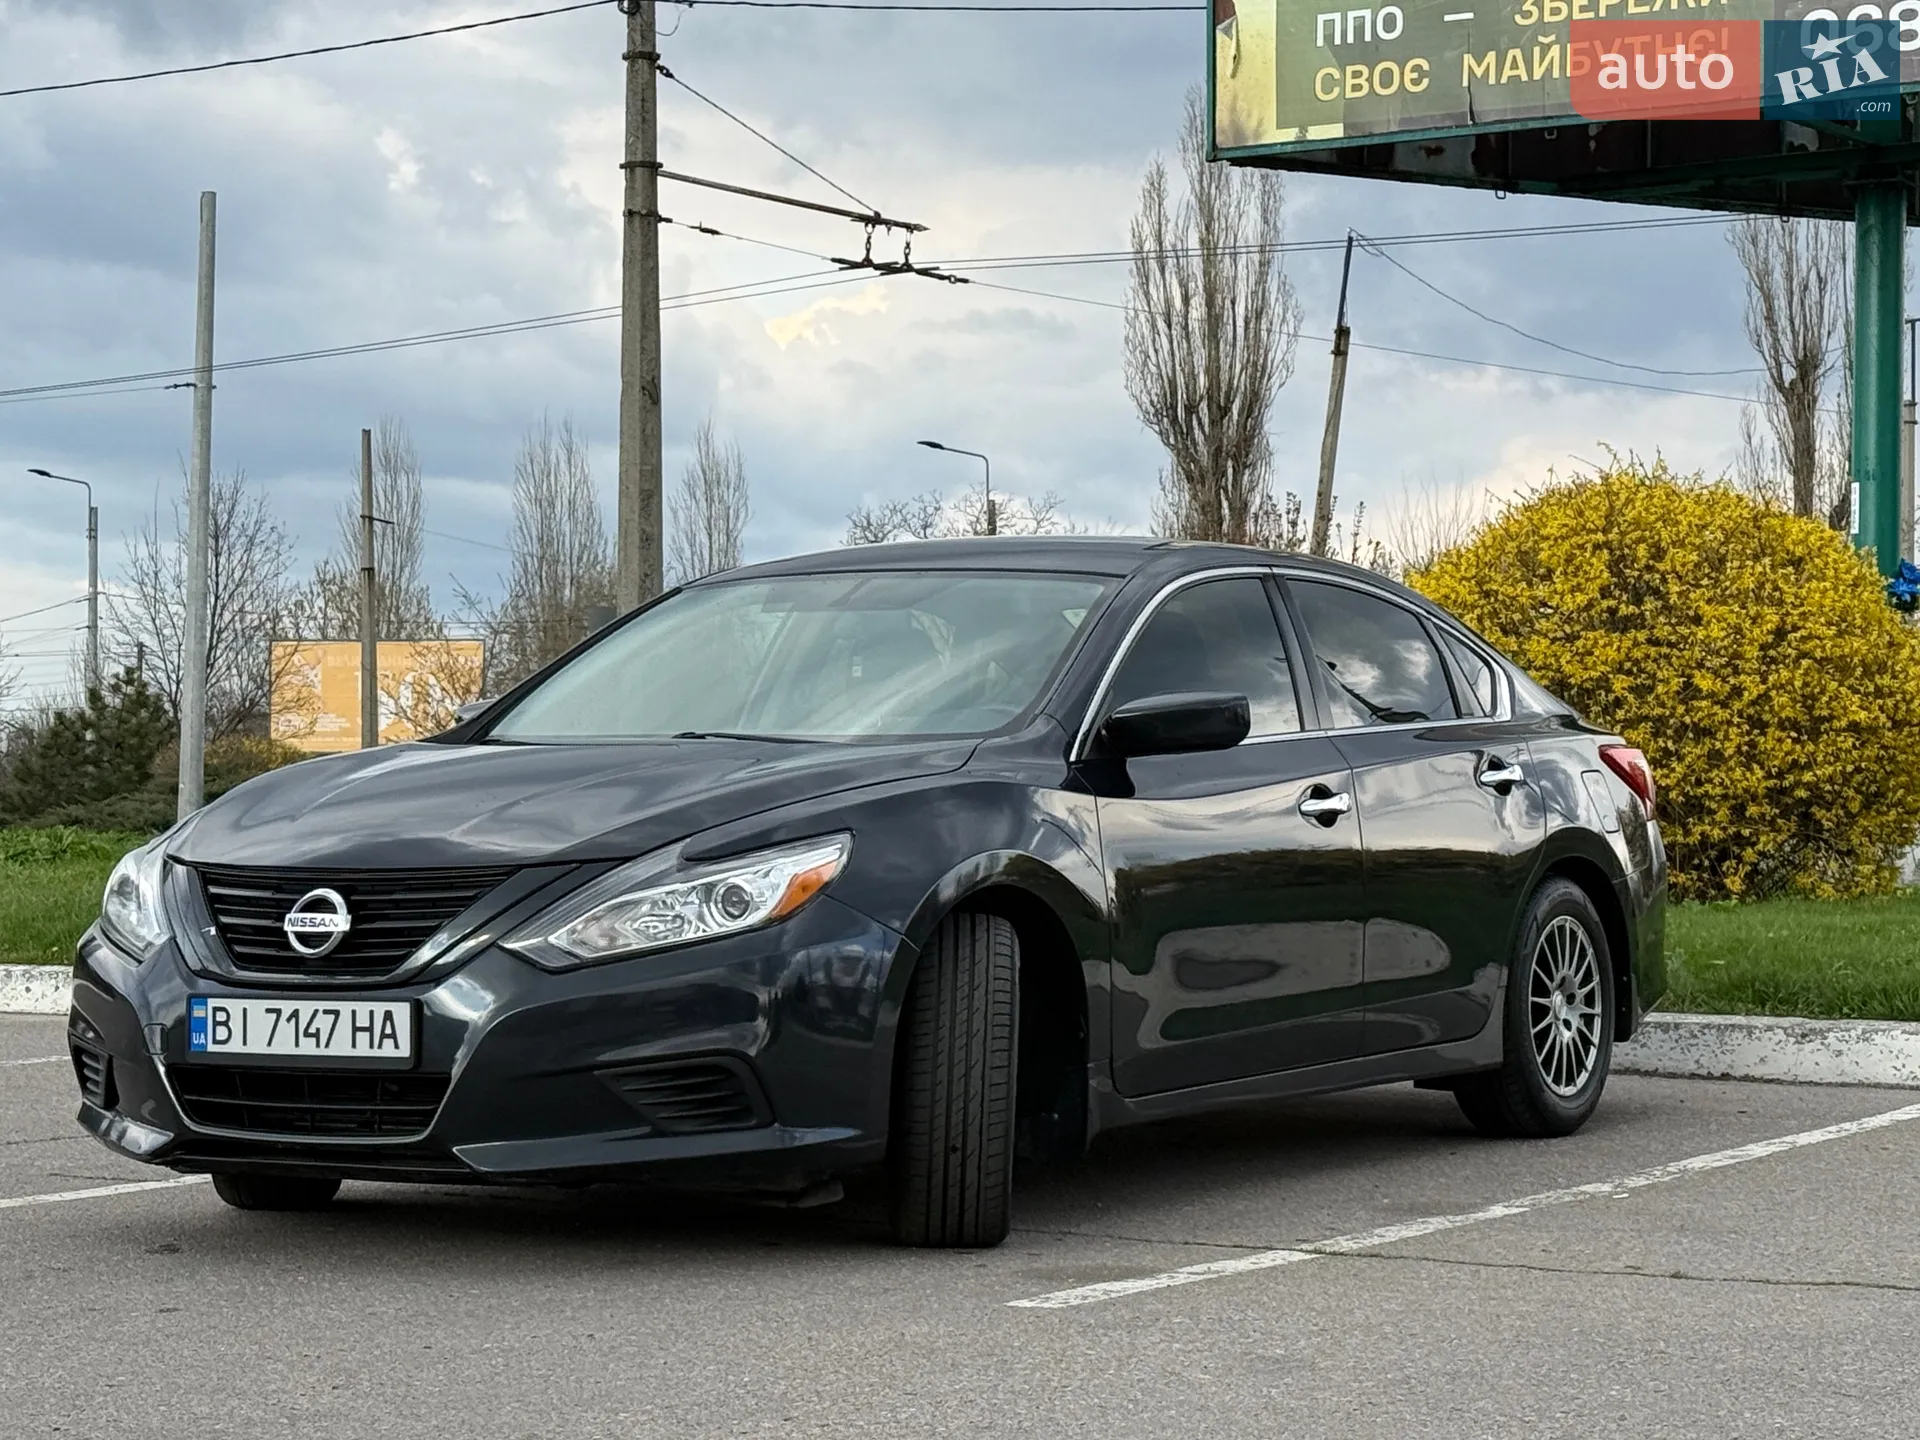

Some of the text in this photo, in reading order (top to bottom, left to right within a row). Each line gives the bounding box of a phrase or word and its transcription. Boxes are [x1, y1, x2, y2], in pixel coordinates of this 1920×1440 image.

[1315, 5, 1404, 47] ППО
[1314, 58, 1430, 101] СВОЄ
[286, 916, 340, 929] NISSAN
[192, 1032, 206, 1045] UA
[211, 1006, 400, 1050] BI 7147 HA
